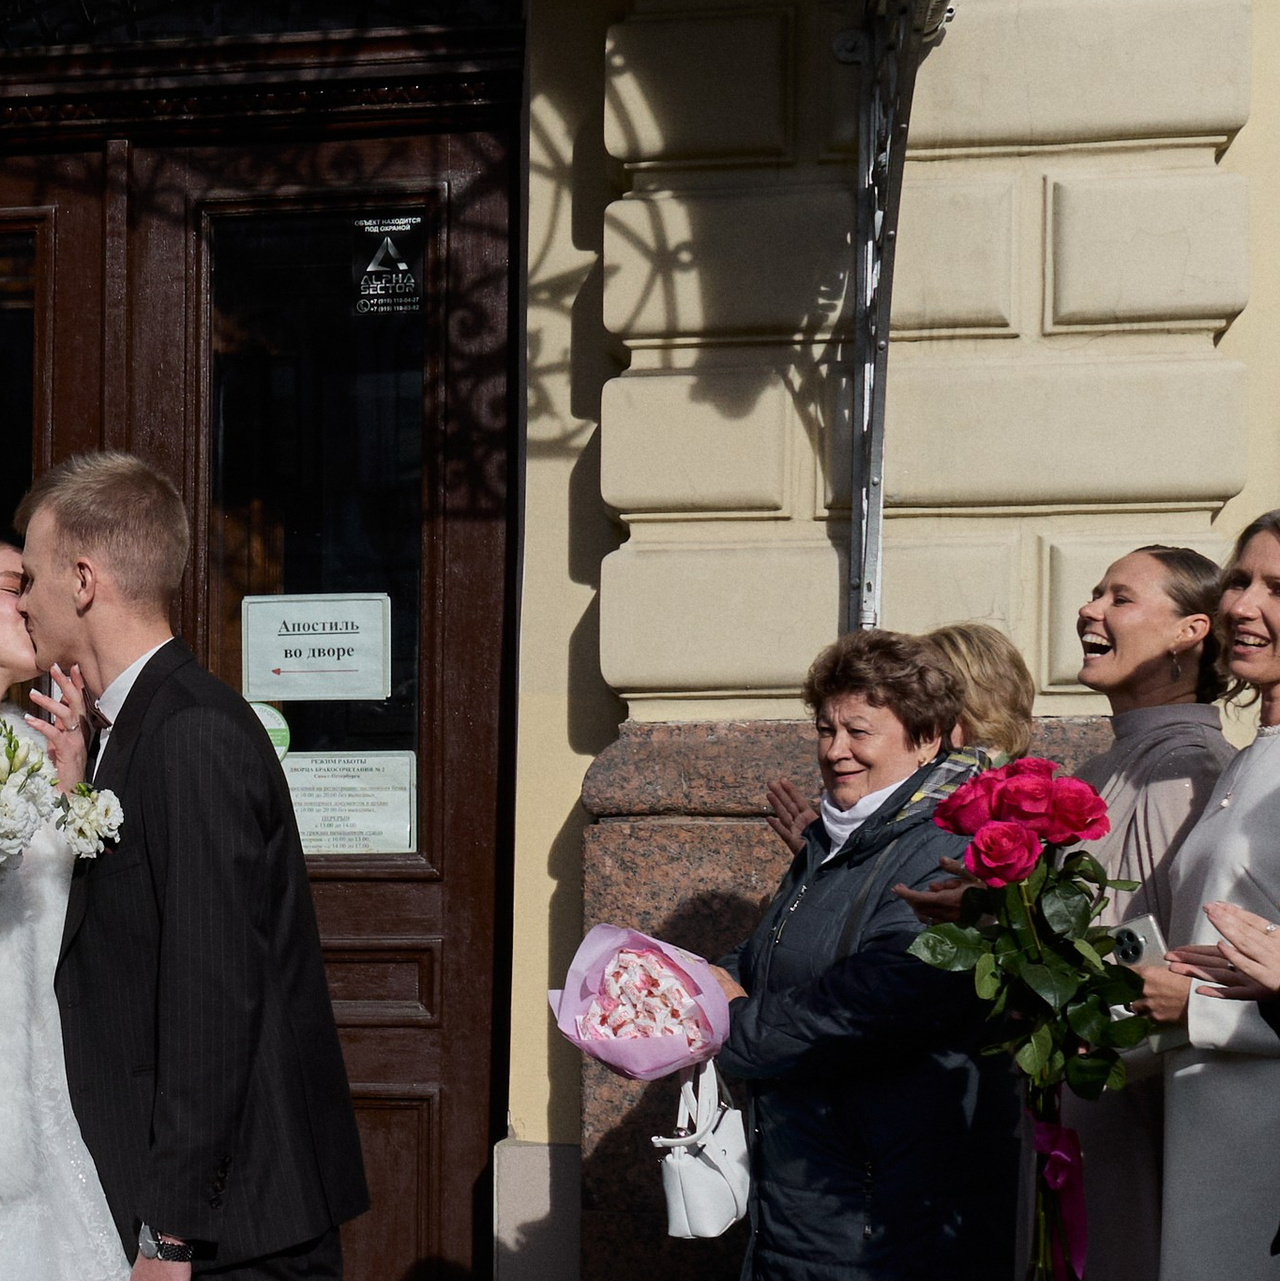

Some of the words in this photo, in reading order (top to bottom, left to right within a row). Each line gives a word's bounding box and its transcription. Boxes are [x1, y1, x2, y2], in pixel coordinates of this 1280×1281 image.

[381, 217, 421, 225] НАХОДИТСЯ
[380, 224, 411, 232] ОХРАНОЙ
[360, 273, 415, 285] ALPHA
[360, 283, 414, 295] SECTOR
[278, 619, 360, 633] Апостиль
[284, 648, 302, 659] во
[307, 646, 355, 661] дворе
